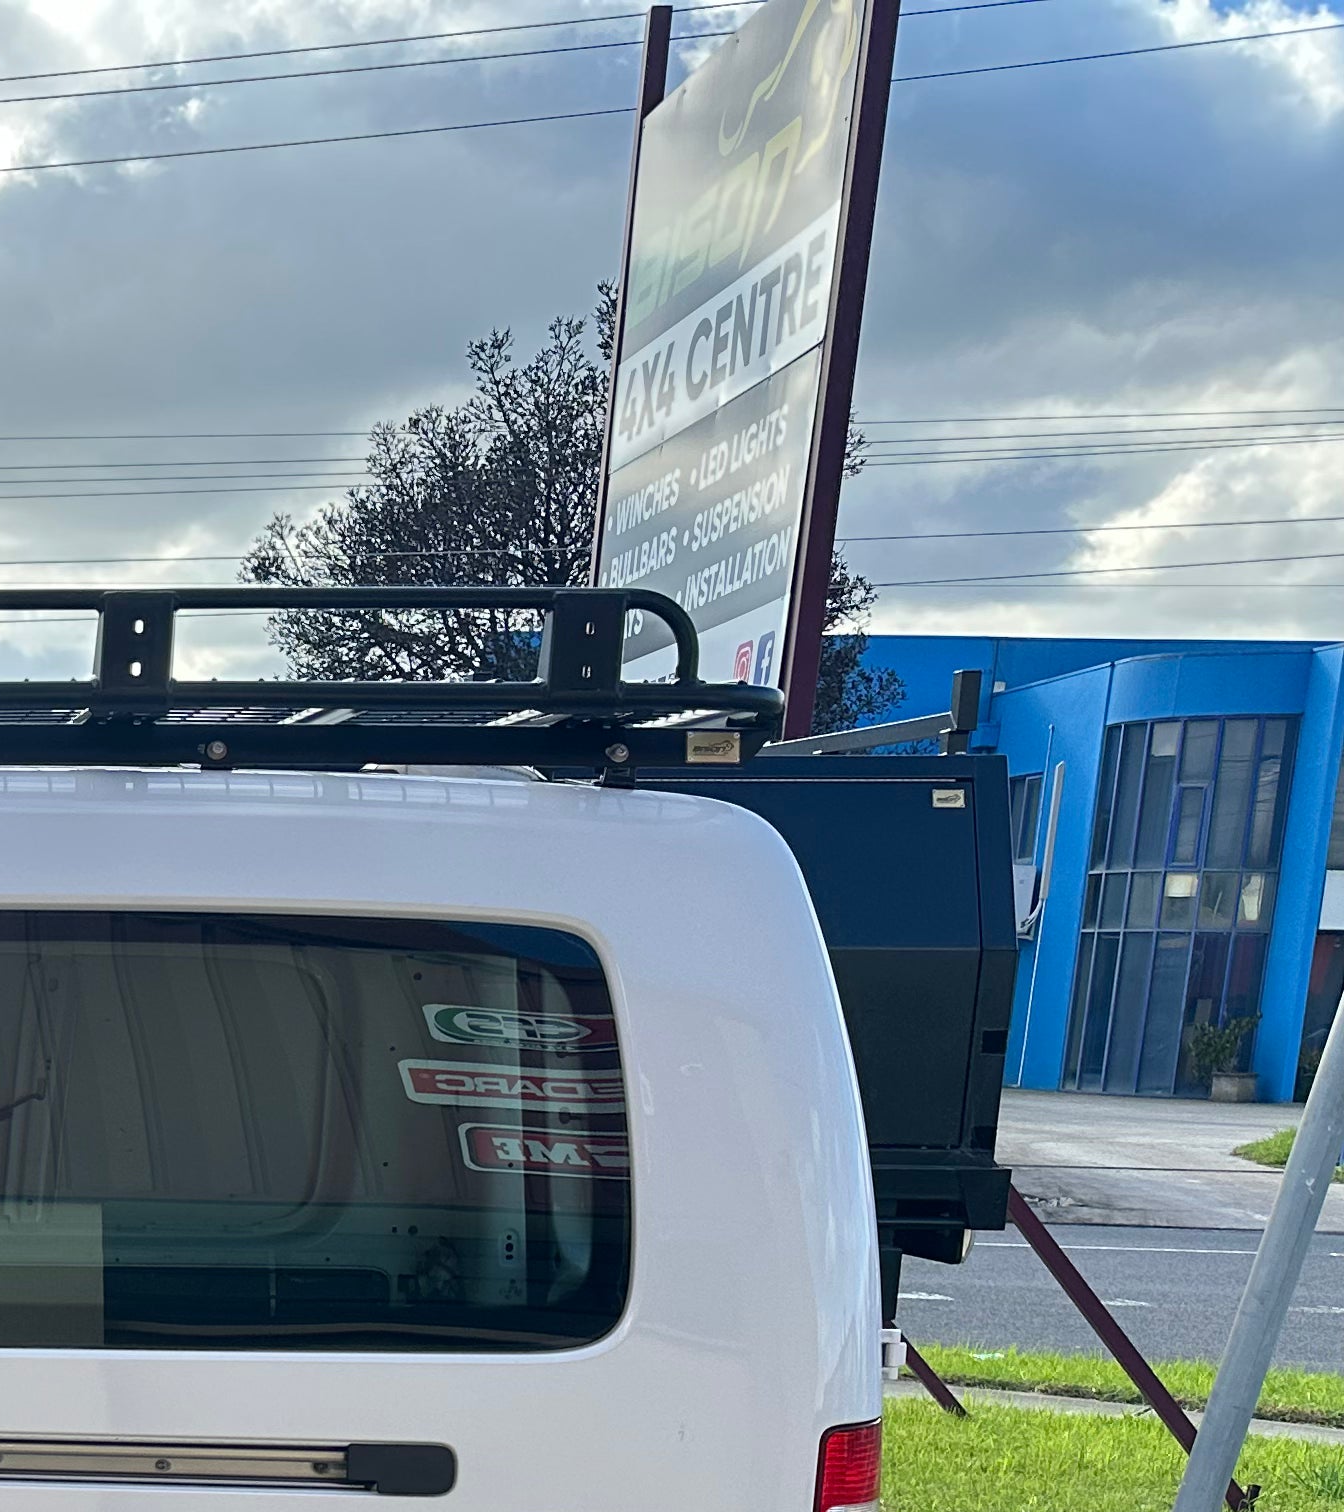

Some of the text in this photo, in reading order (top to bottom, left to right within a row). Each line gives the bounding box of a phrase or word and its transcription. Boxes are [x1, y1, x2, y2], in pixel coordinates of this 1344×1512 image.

[618, 230, 826, 442] 4X4 CENTRE
[698, 405, 788, 491] LED LIGHTS
[616, 467, 680, 536] WINCHES
[691, 463, 790, 551] SUSPENSION
[610, 526, 677, 588] BULLBARS
[683, 526, 792, 612] INSTALLATION
